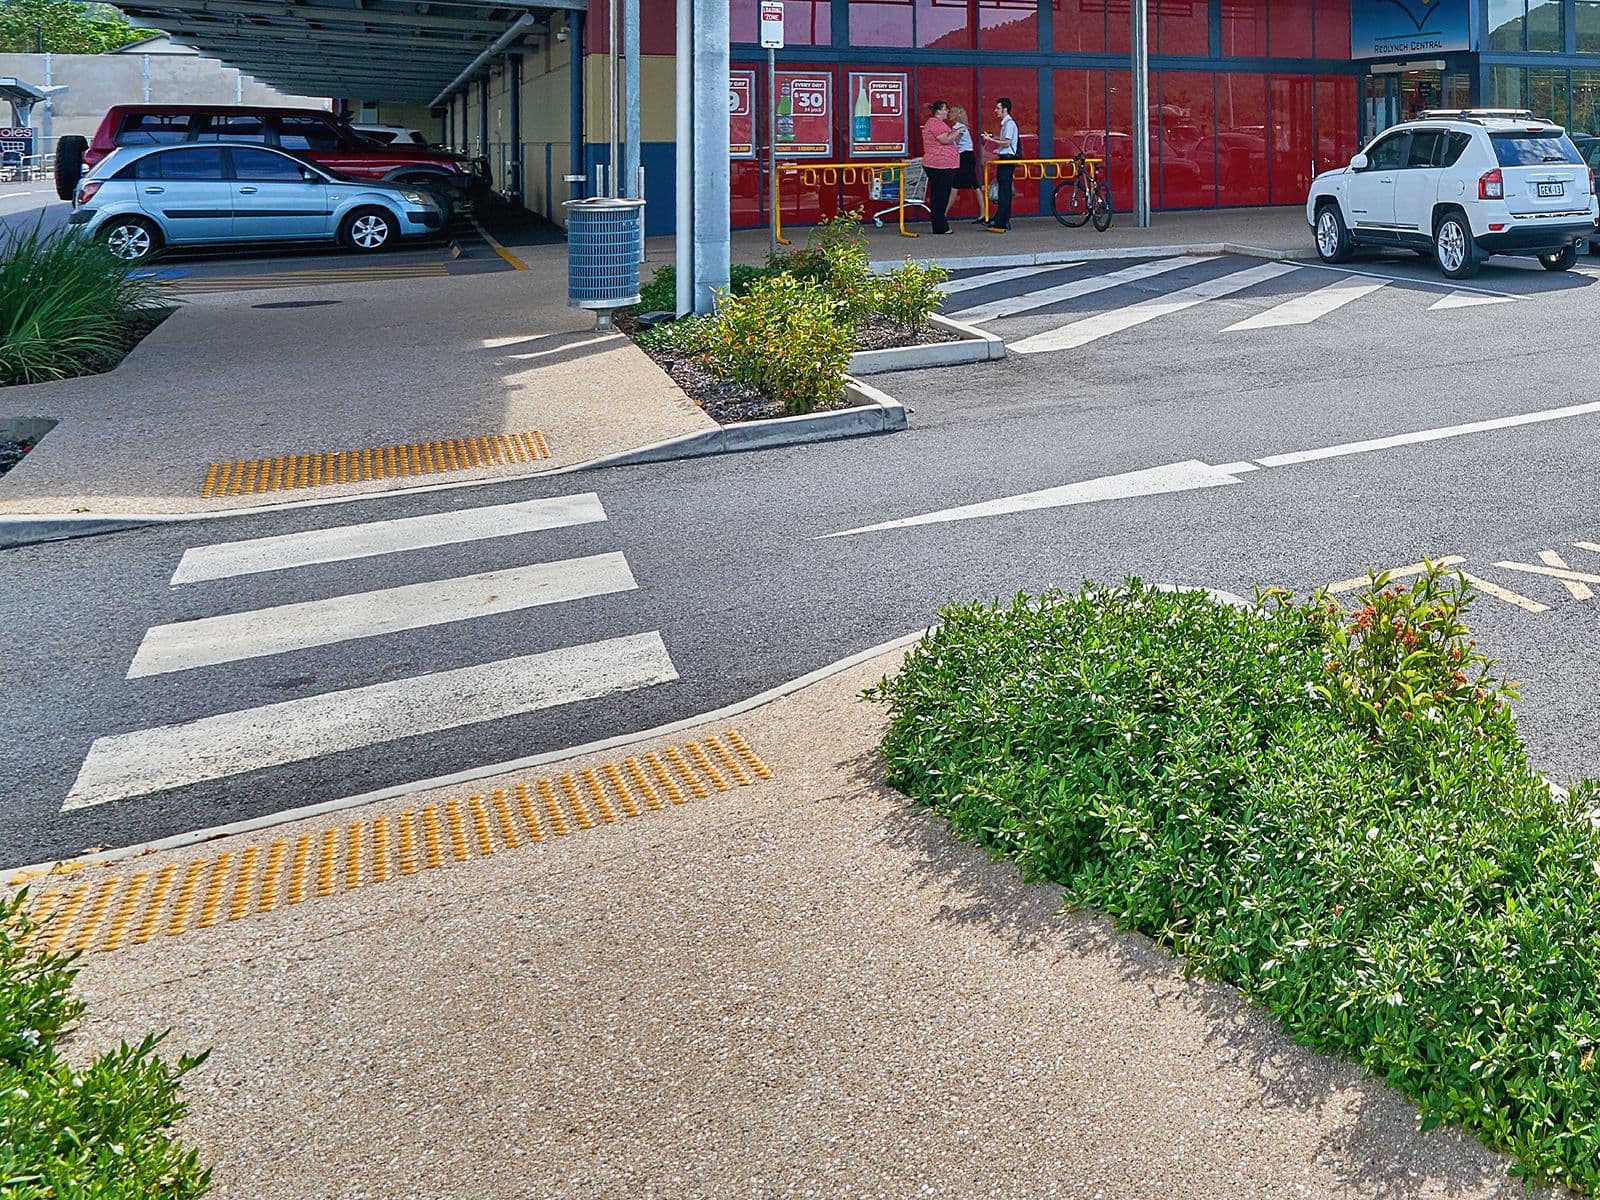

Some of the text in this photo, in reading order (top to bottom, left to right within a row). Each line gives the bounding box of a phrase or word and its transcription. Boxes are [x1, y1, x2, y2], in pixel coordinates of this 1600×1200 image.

[1374, 40, 1443, 54] REDLYNCH CENTRAL
[794, 92, 823, 107] $30
[875, 93, 896, 107] $11
[0, 128, 32, 137] oles
